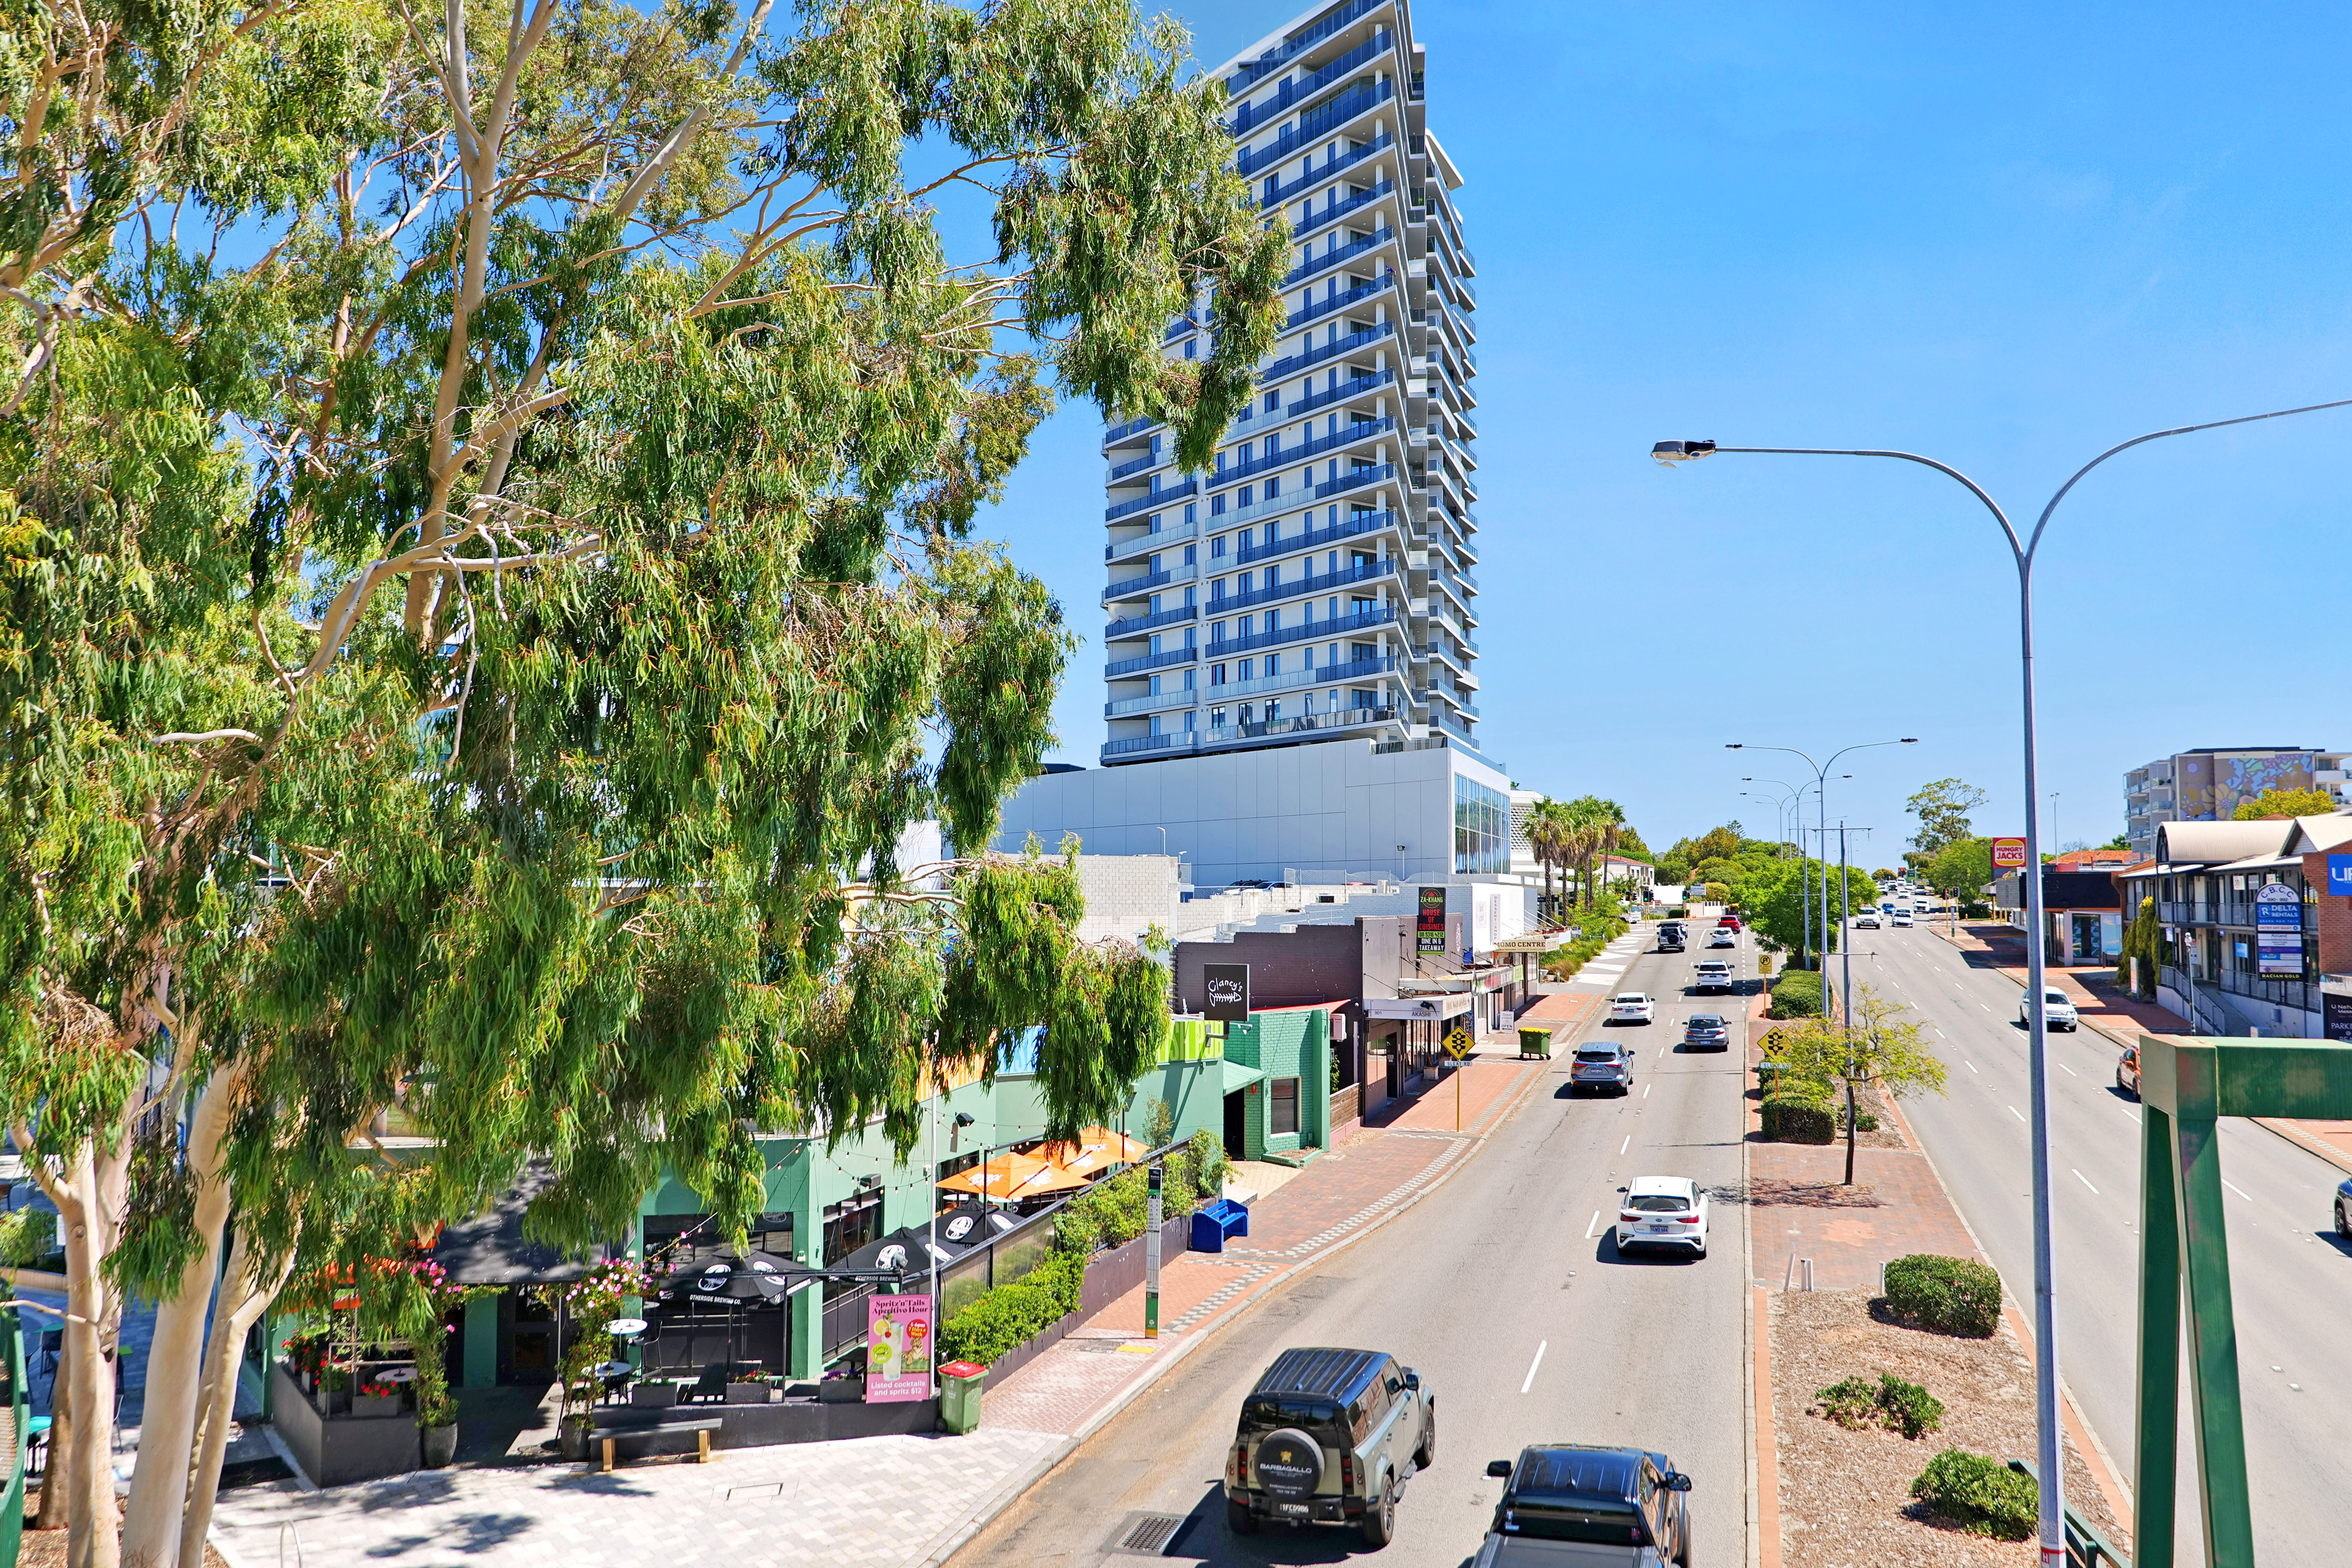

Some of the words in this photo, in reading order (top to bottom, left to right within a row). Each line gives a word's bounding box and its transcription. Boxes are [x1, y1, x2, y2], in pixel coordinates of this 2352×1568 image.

[1208, 977, 1243, 992] Clancy's
[1195, 1020, 1223, 1060] PUB
[690, 1294, 713, 1302] OTHERSIDE
[872, 1306, 907, 1315] Aperitivo
[871, 1381, 893, 1389] Listed
[894, 1380, 926, 1388] cocktails
[889, 1388, 909, 1396] spritz
[1259, 1463, 1312, 1474] BARBAGALLO
